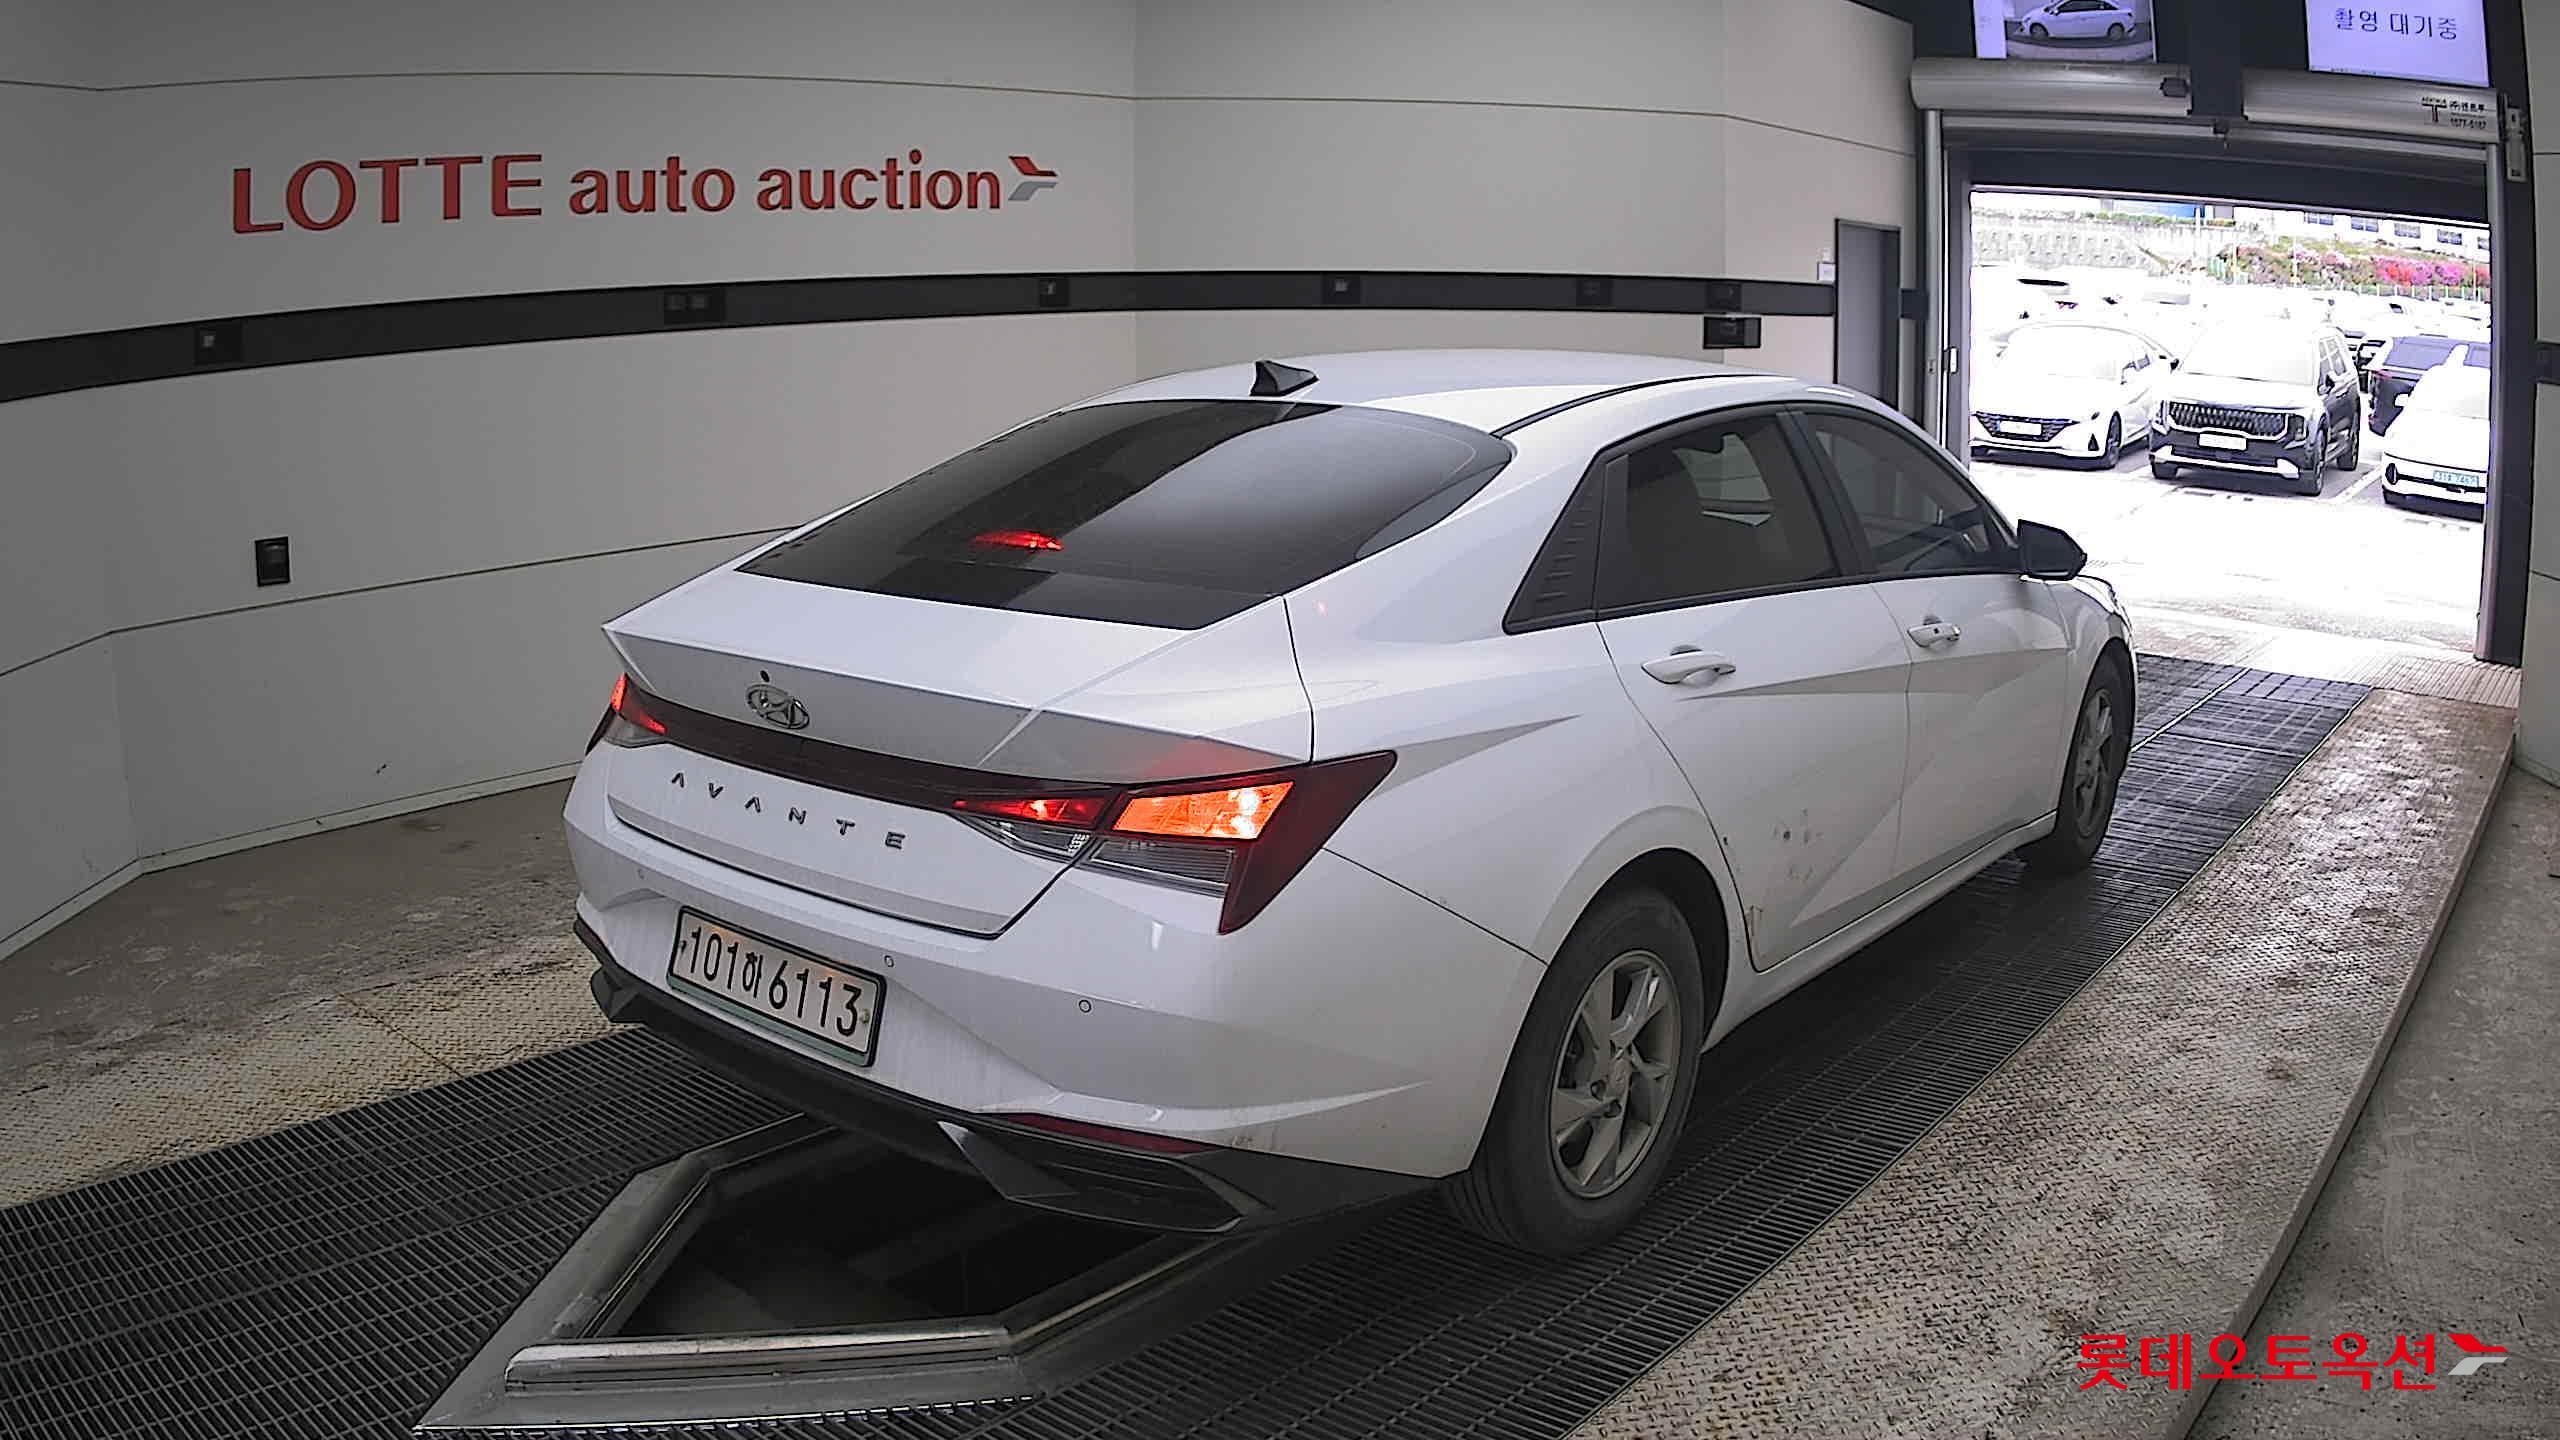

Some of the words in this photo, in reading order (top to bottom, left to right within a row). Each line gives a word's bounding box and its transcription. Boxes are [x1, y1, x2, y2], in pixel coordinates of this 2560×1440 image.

[2389, 13, 2457, 40] 대기중
[232, 154, 543, 234] LOTTE
[568, 154, 736, 214] auto
[756, 150, 1002, 211] auction
[671, 771, 907, 850] AVANTE
